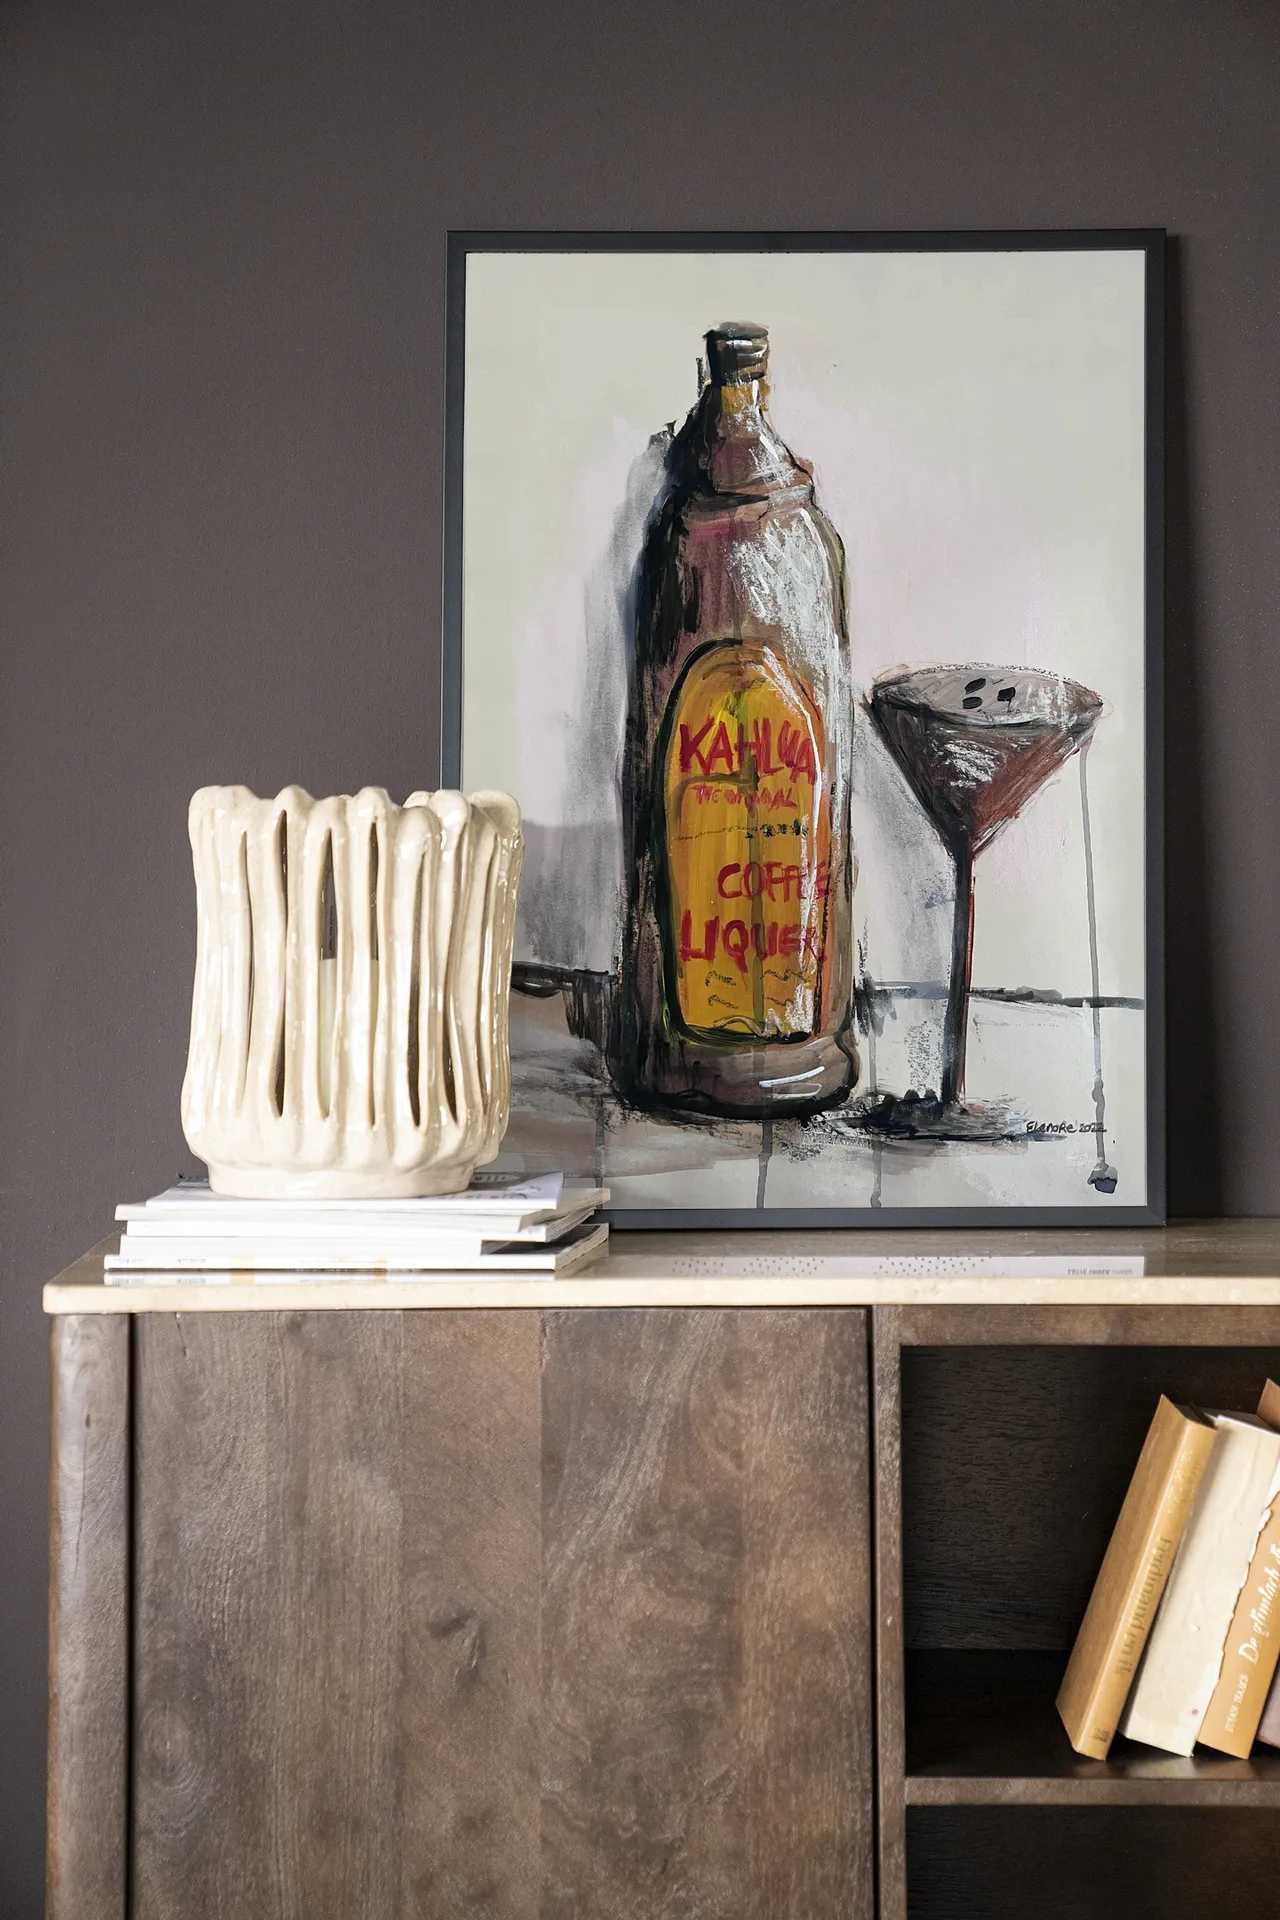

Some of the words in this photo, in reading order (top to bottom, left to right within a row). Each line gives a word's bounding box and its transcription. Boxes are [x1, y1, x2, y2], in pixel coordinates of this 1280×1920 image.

[679, 715, 818, 785] KAHLUA
[1130, 1536, 1173, 1632] Ferdinand
[1238, 1637, 1260, 1665] De
